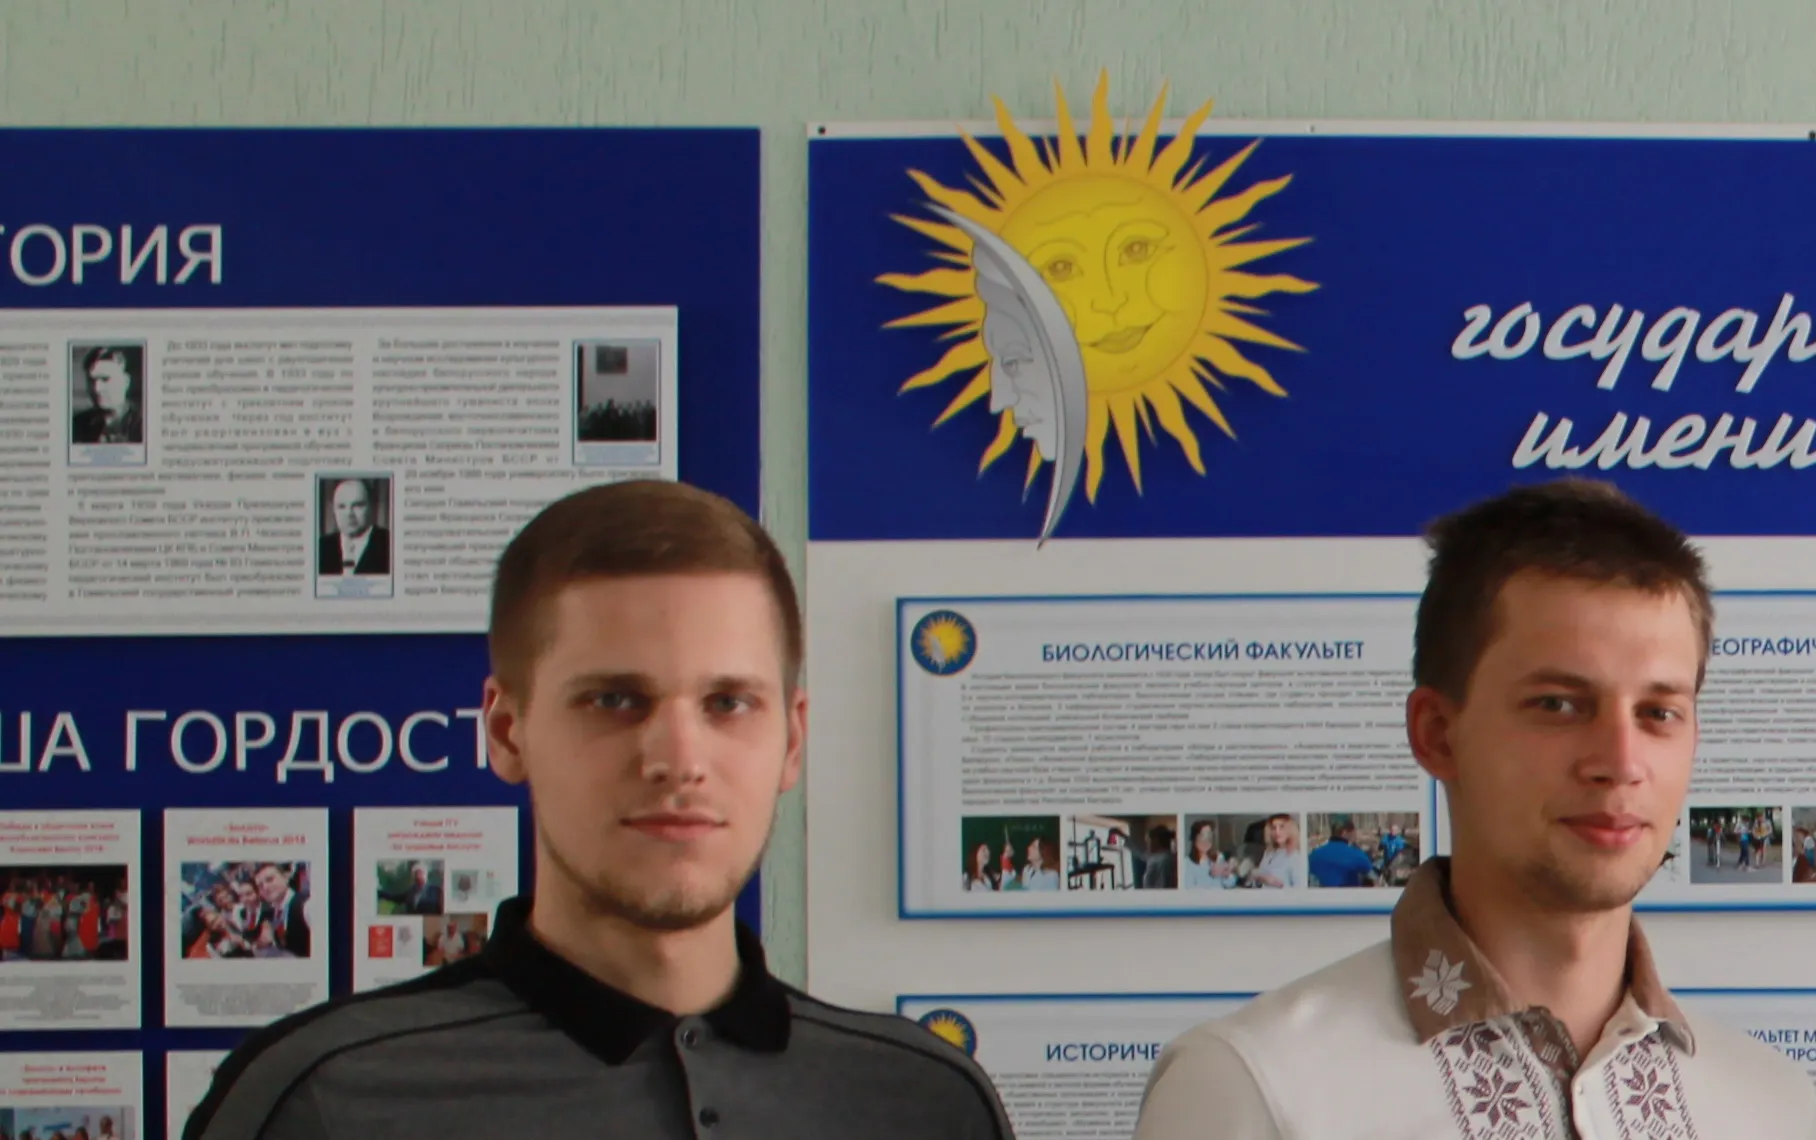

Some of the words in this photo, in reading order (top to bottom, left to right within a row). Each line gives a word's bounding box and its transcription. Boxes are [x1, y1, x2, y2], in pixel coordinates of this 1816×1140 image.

[0, 223, 222, 286] ОРИЯ
[1041, 638, 1239, 662] БИОЛОГИЧЕСКИЙ
[1246, 641, 1365, 661] ФАКУЛЬТЕТ
[125, 709, 490, 784] ГОРДОСТ
[1749, 1029, 1799, 1044] УЛЬТЕТ
